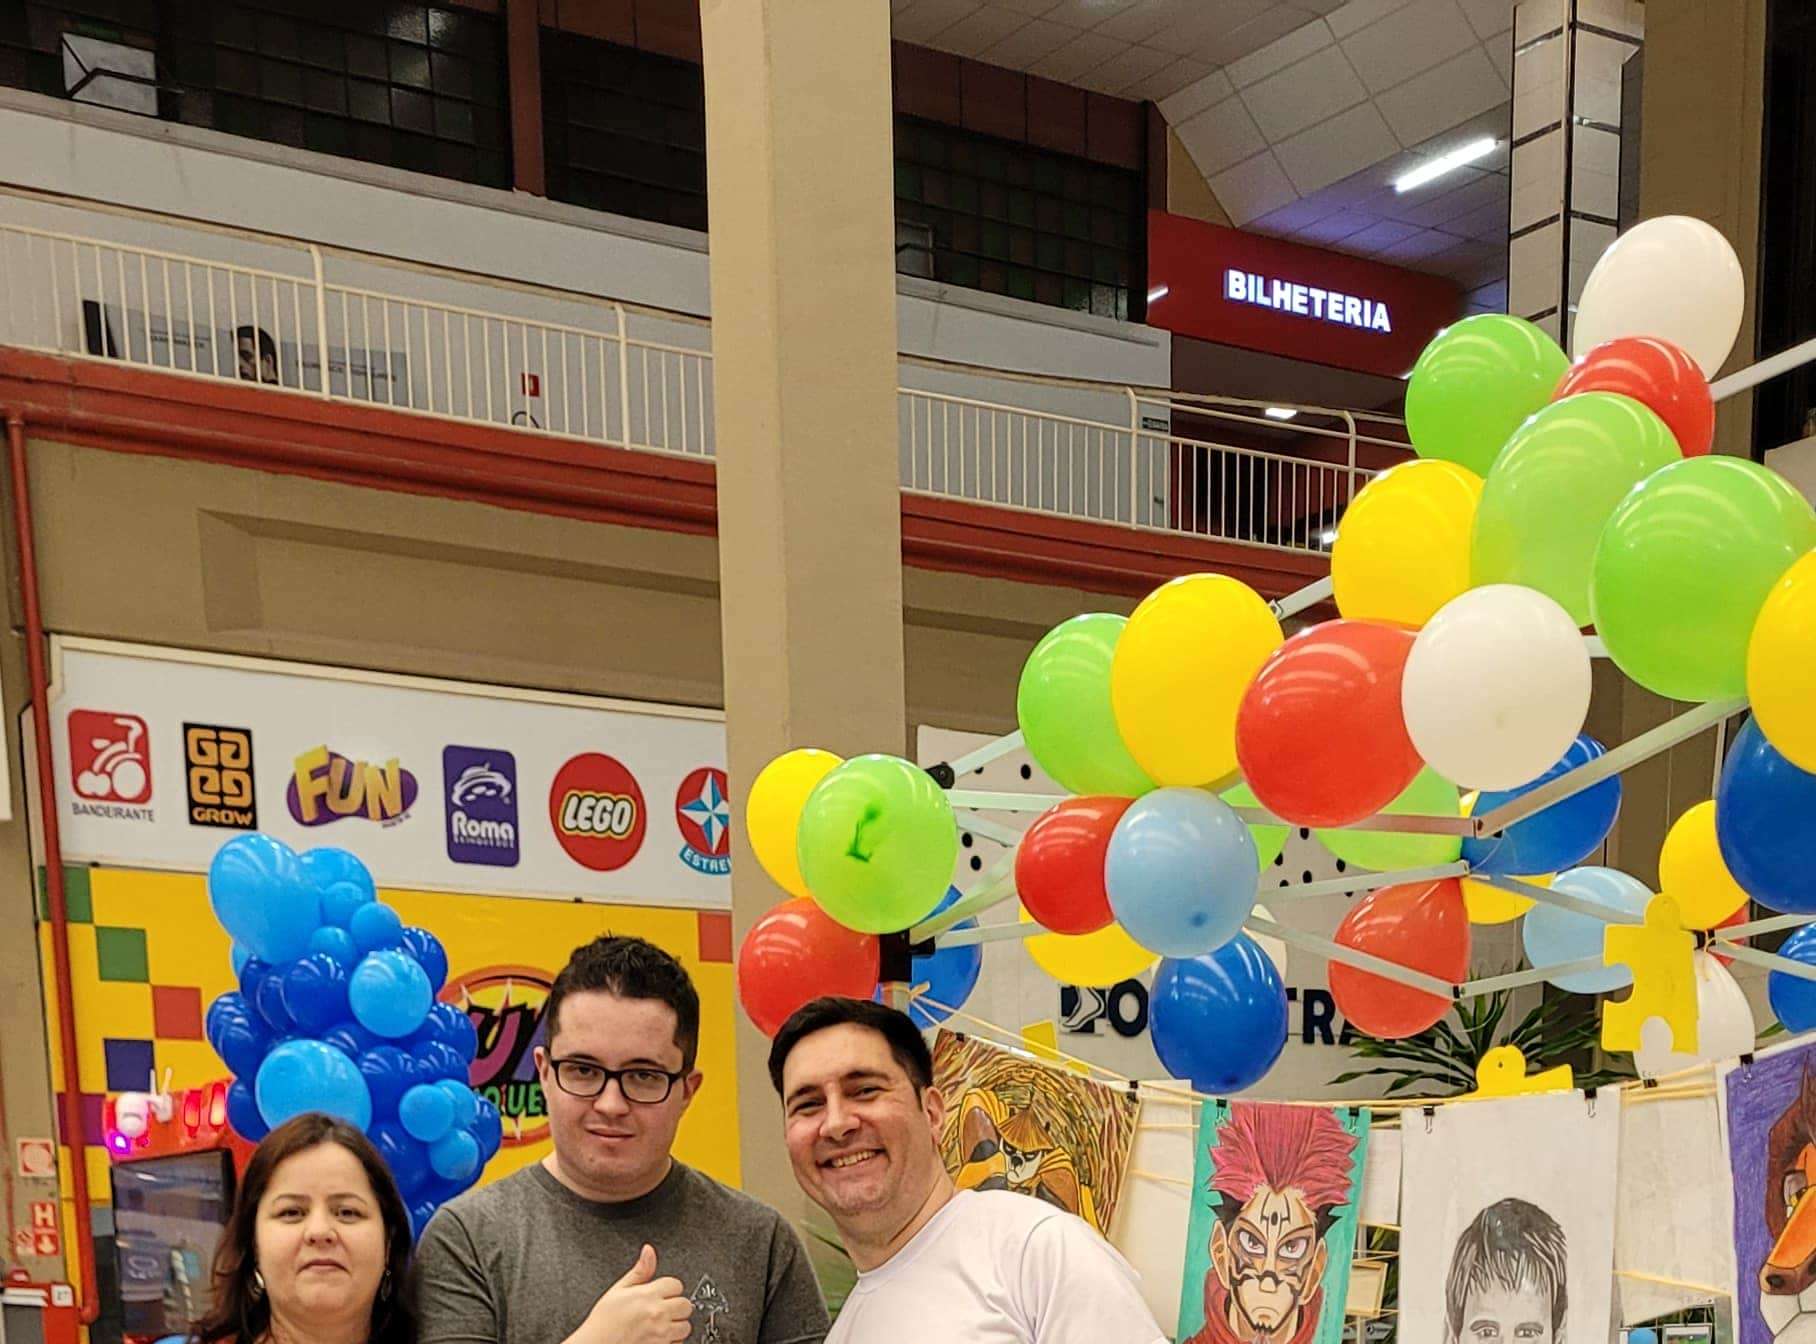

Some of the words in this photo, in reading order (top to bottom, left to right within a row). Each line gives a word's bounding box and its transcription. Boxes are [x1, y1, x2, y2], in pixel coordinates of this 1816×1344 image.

[1225, 268, 1392, 333] BILHETERIA
[294, 744, 402, 823] FUN
[72, 803, 155, 822] BANDEIRANTE
[192, 807, 253, 826] GROW
[452, 810, 515, 841] Roma
[563, 794, 632, 835] LEGO
[683, 847, 732, 874] ESTRE
